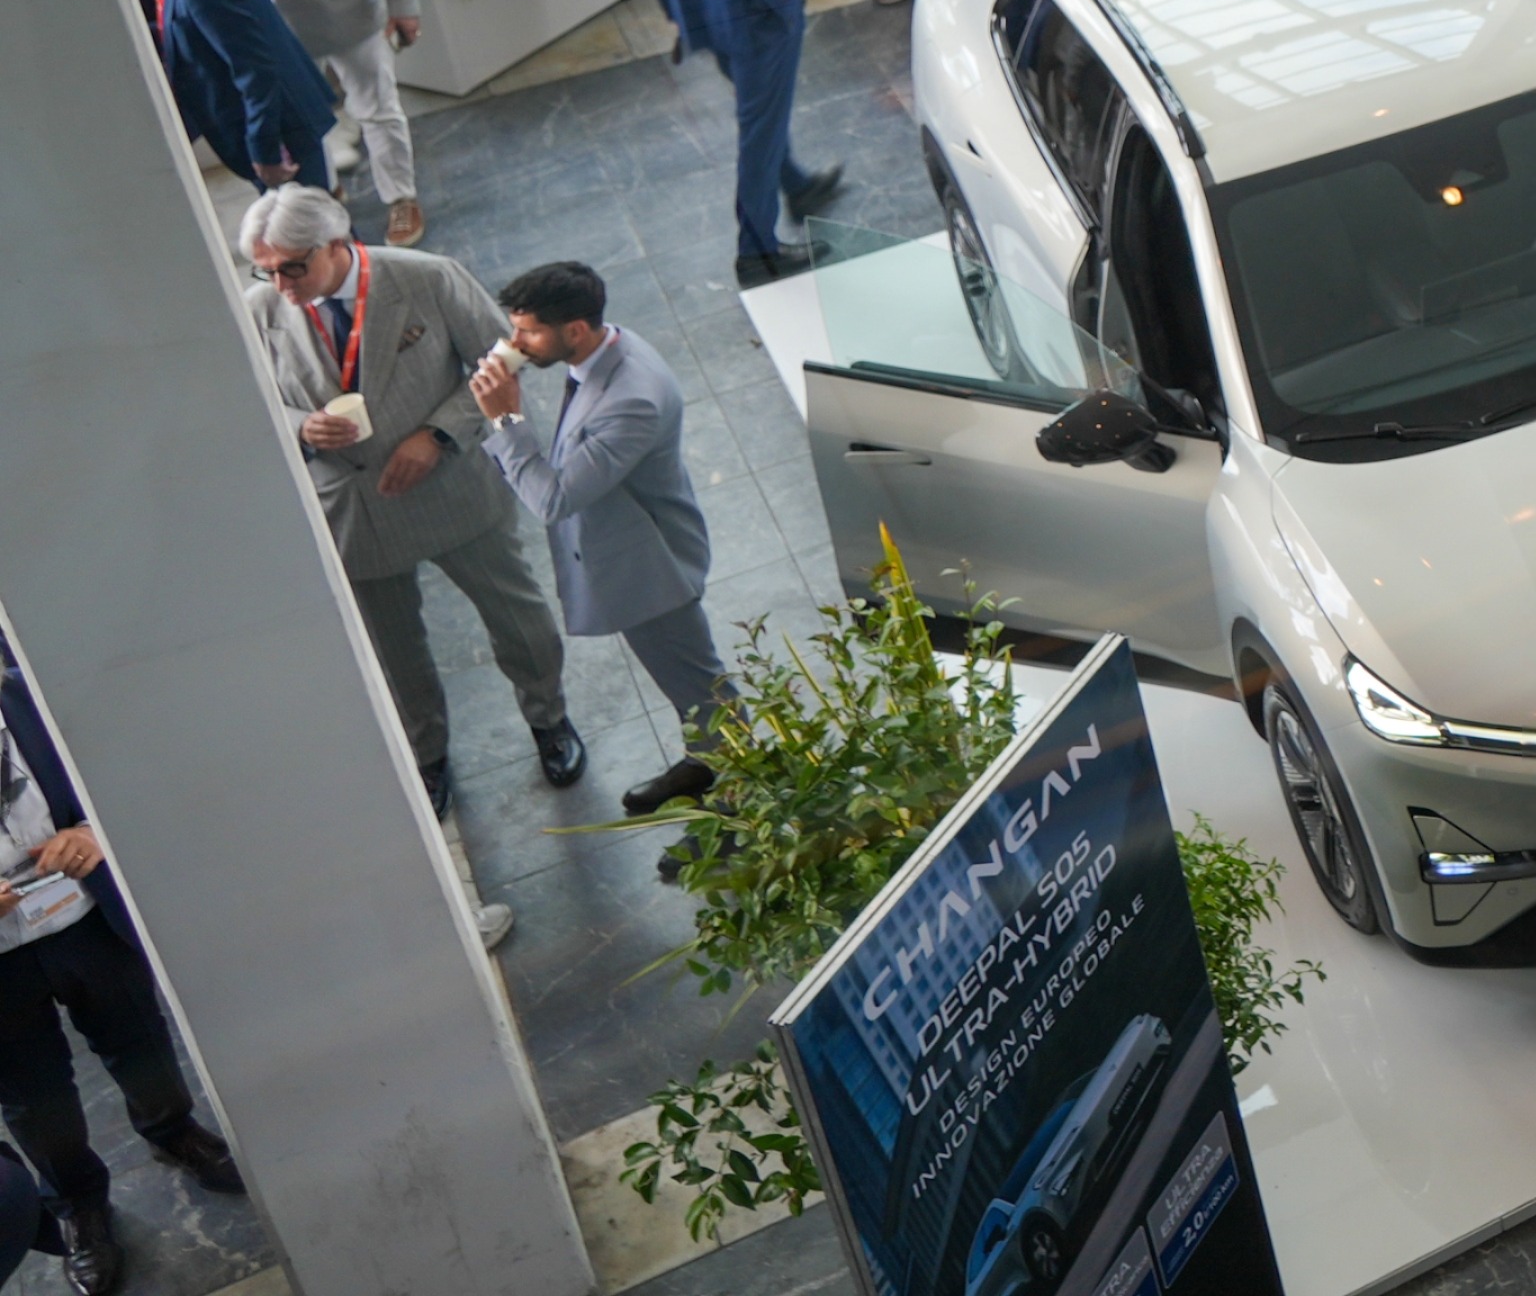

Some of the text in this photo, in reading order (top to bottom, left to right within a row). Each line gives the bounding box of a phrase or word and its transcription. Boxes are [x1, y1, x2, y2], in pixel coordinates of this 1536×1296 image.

[863, 723, 1101, 1022] CHANGAN
[906, 844, 1116, 1116] ULTRA-HYBRID
[917, 829, 1092, 1056] DEEPAL S05
[912, 894, 1145, 1198] INNOVAZIONE GLOBALE
[940, 909, 1112, 1133] DESIGN EUROPEO
[1165, 1145, 1212, 1210] ULTRA
